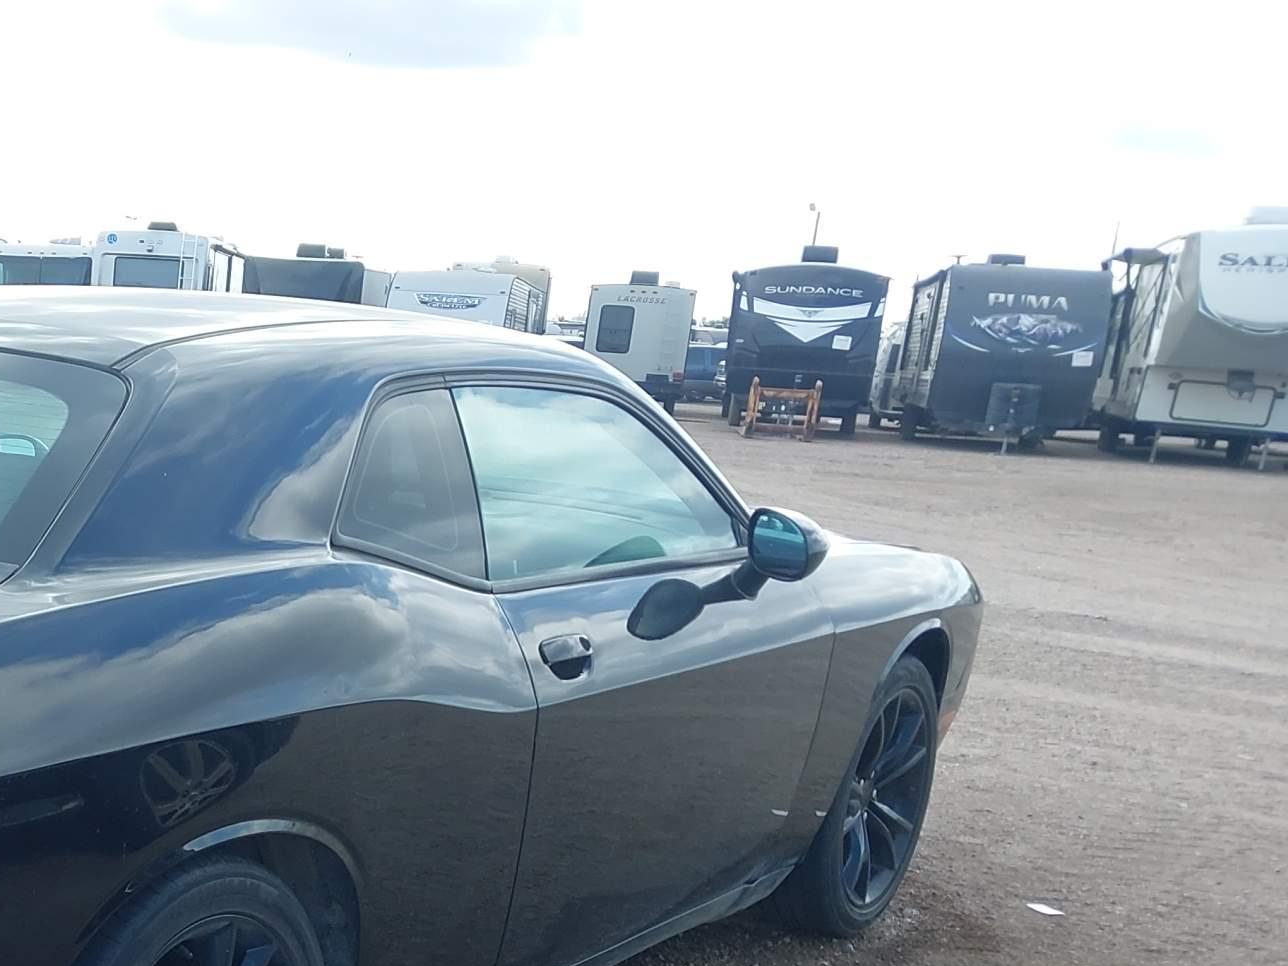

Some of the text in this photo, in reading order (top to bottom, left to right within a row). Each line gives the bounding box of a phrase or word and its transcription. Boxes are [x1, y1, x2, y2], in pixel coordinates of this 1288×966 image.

[1218, 252, 1288, 266] SAL
[764, 285, 864, 298] SUNDANCE
[988, 292, 1069, 311] PUMA
